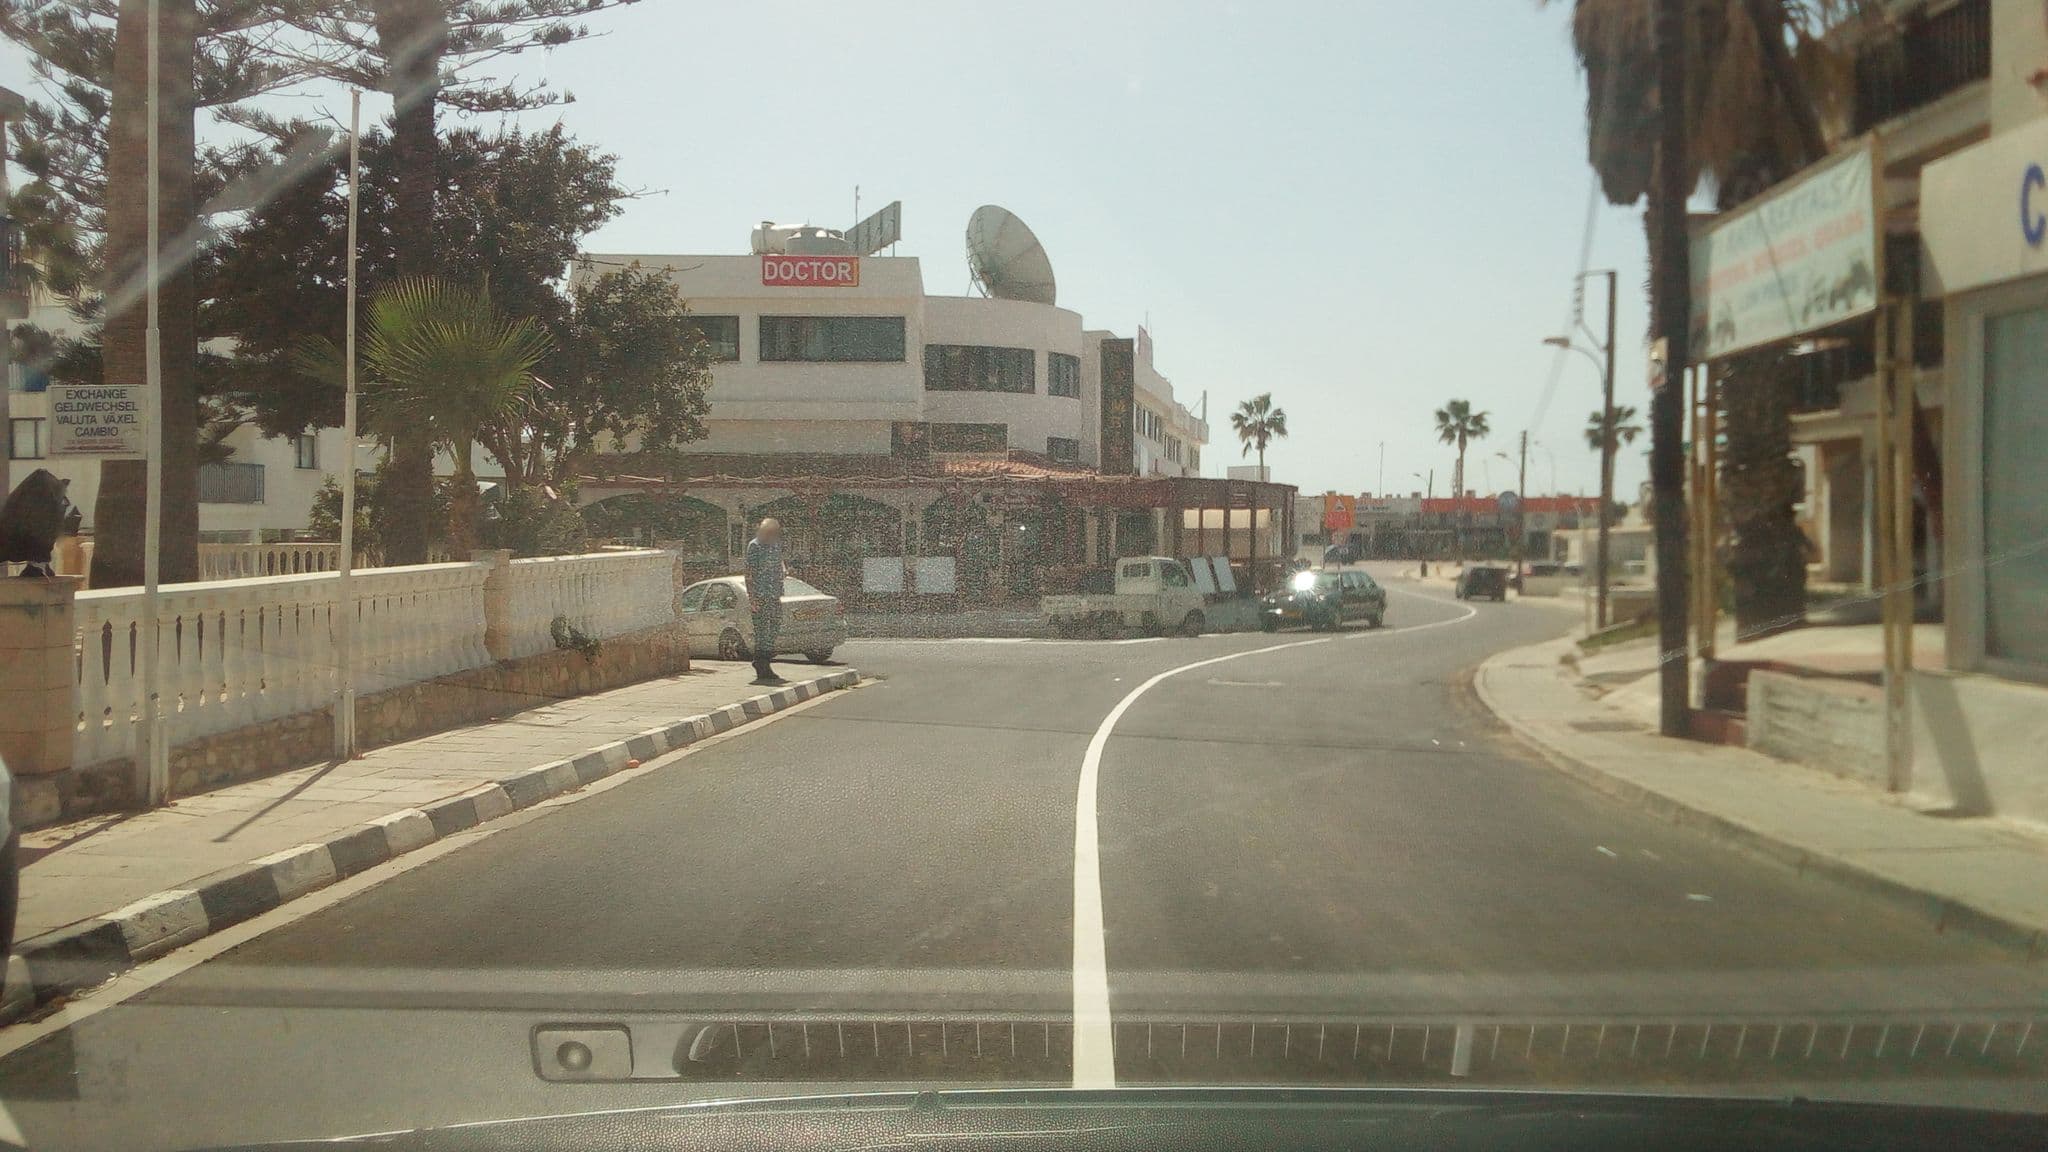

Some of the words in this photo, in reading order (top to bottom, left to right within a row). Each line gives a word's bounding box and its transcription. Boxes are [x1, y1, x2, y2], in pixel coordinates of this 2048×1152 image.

[764, 261, 852, 281] DOCTOR
[66, 389, 127, 399] EXCHANGE
[55, 401, 139, 412] GELDWECHSEL
[56, 414, 98, 425] VALUTA
[75, 426, 119, 438] CAMBIO
